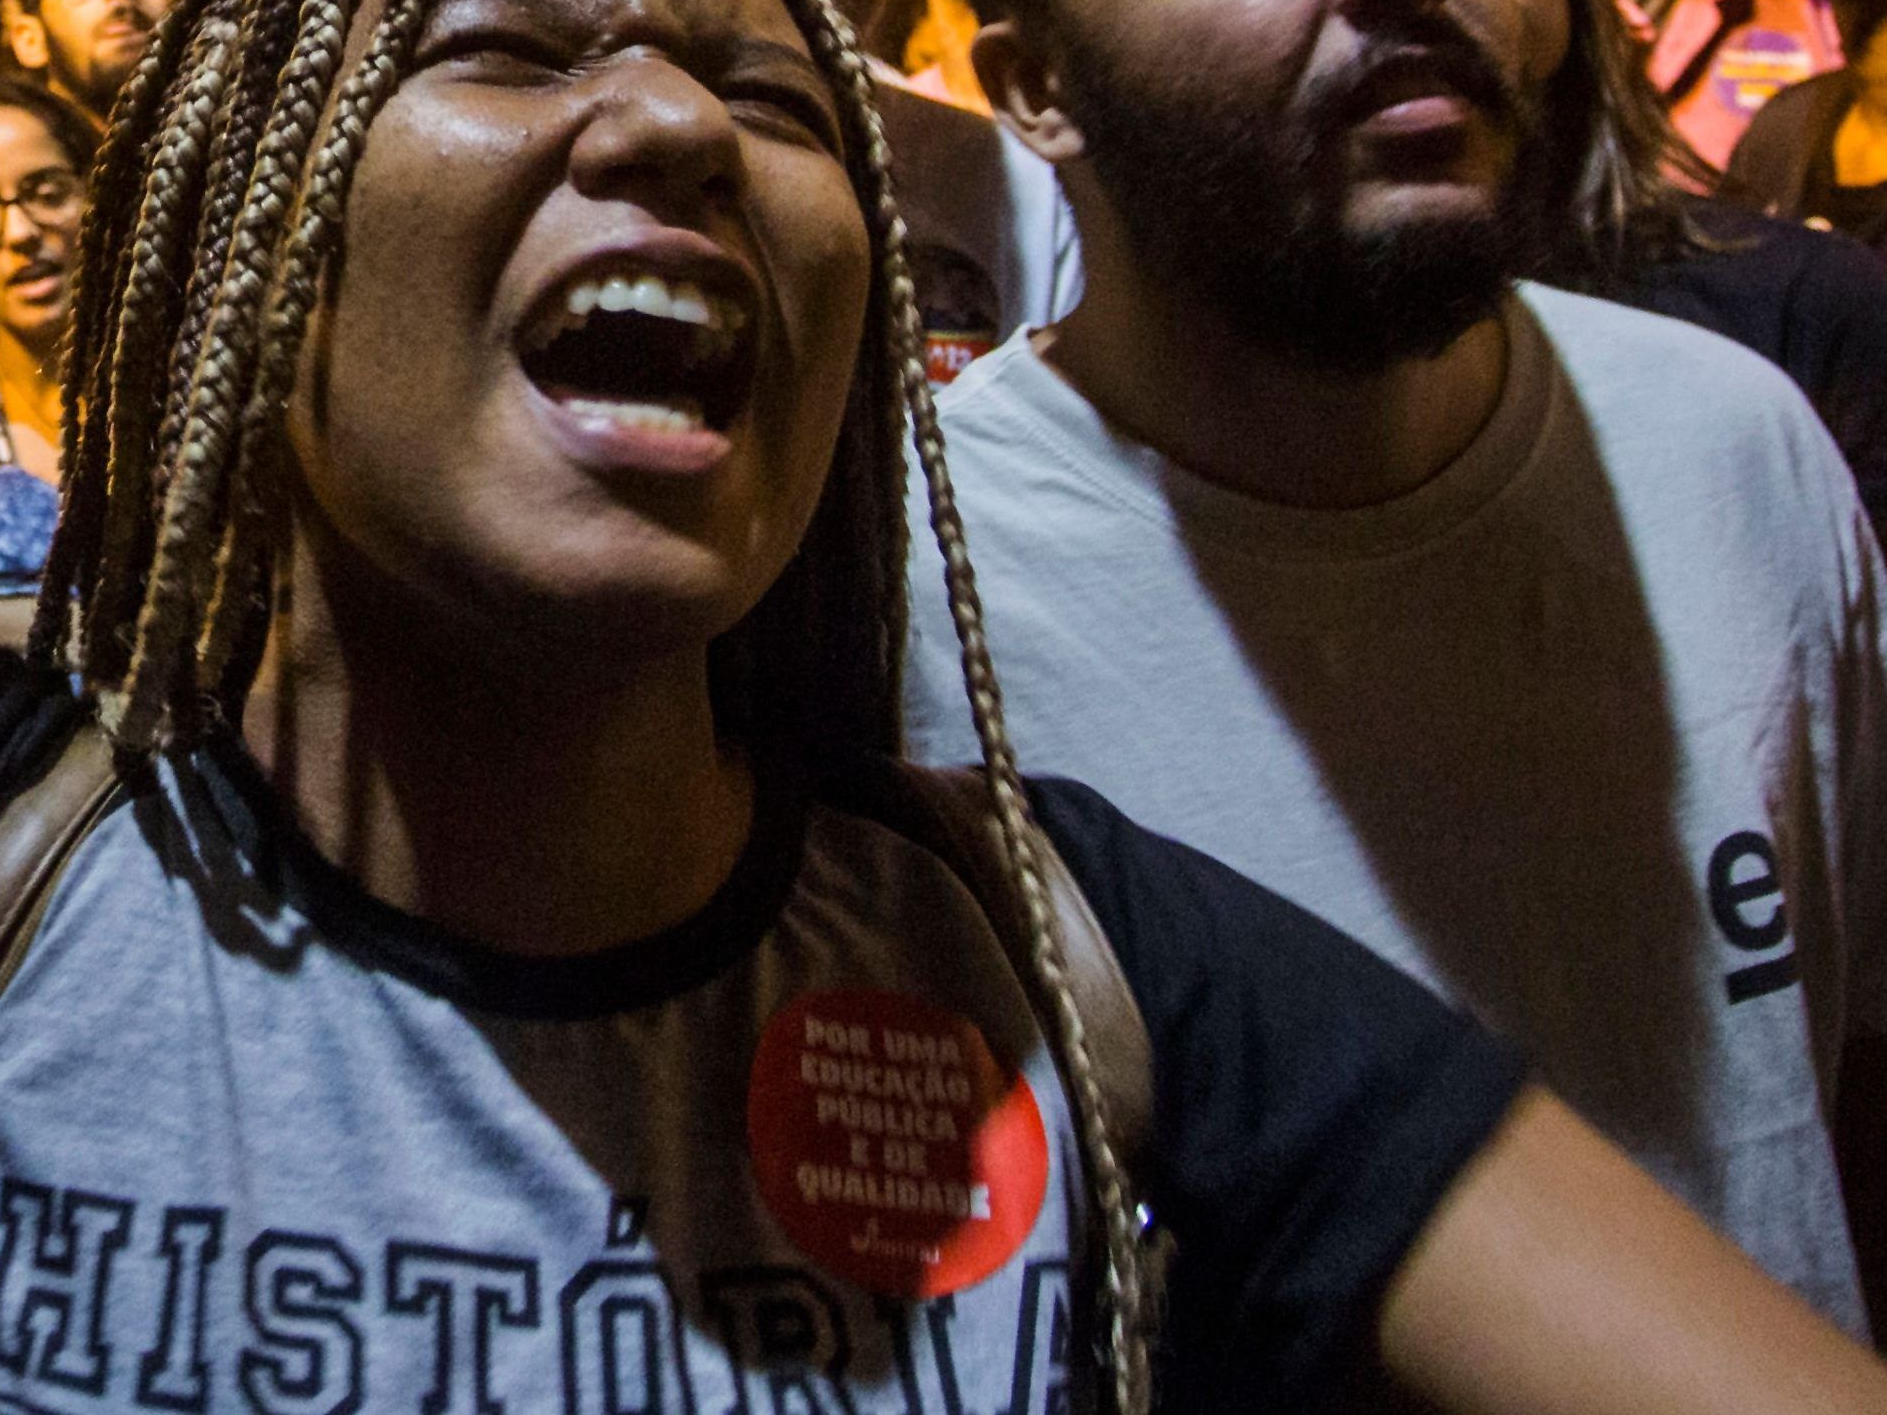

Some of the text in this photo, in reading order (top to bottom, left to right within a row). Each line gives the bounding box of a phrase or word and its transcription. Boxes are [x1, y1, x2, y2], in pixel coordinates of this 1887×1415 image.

[804, 1015, 963, 1066] POR UMA
[882, 1137, 928, 1175] DE
[795, 1158, 992, 1220] QUALIDADE
